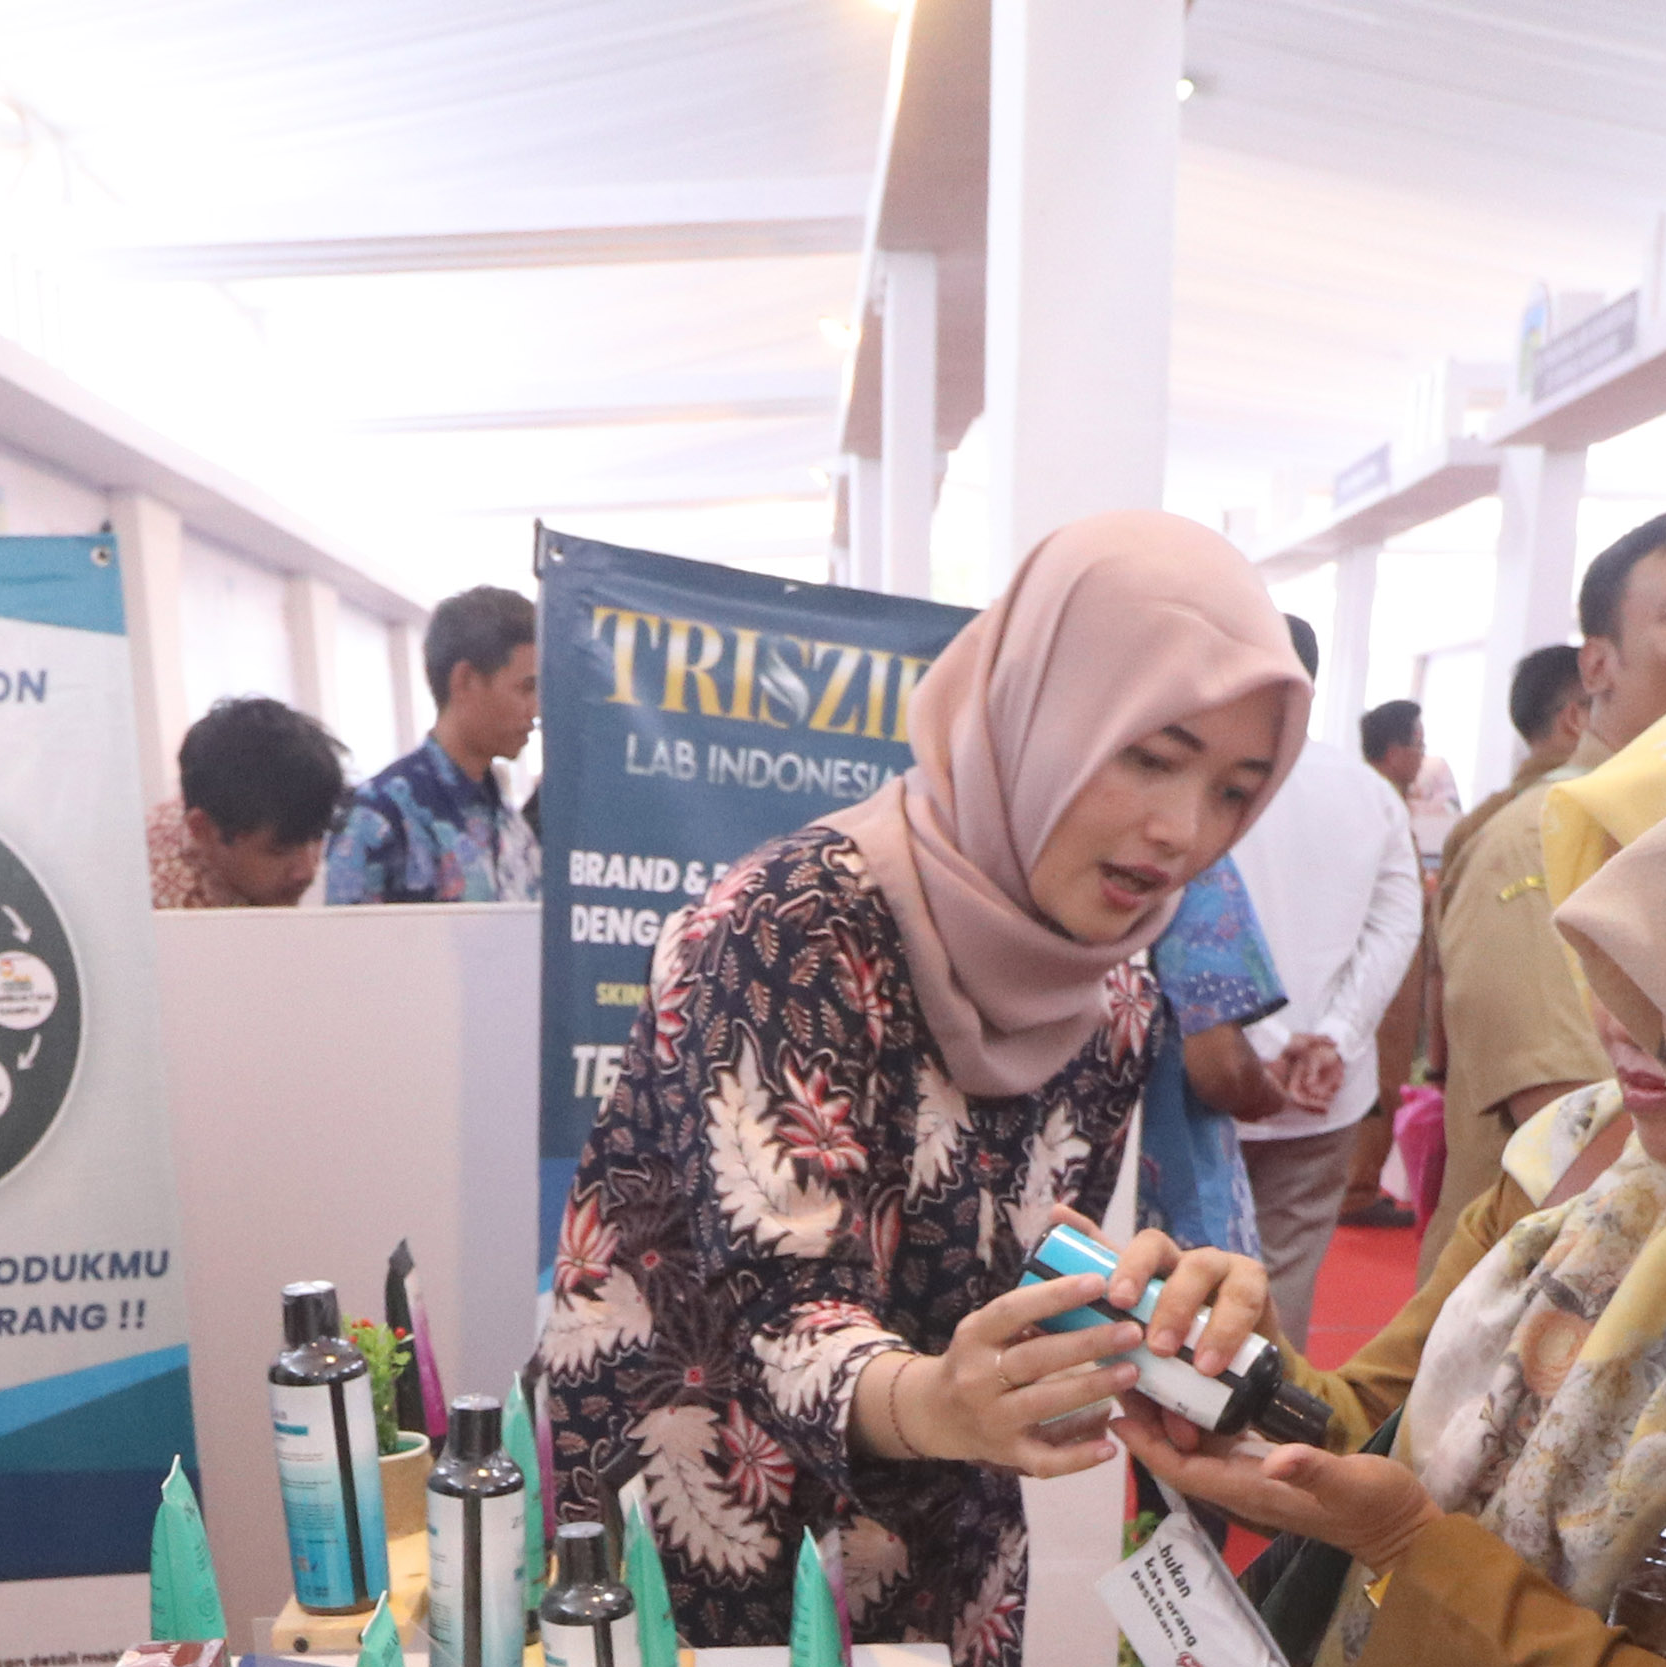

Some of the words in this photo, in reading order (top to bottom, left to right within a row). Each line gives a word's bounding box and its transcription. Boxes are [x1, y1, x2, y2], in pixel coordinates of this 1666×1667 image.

[626, 735, 697, 781] LAB
[569, 849, 680, 891] BRAND
[683, 861, 710, 896] &
[119, 1300, 146, 1330] !!
[1143, 1555, 1168, 1602] kata
[1167, 1599, 1200, 1649] orang
[29, 1651, 78, 1667] detail
